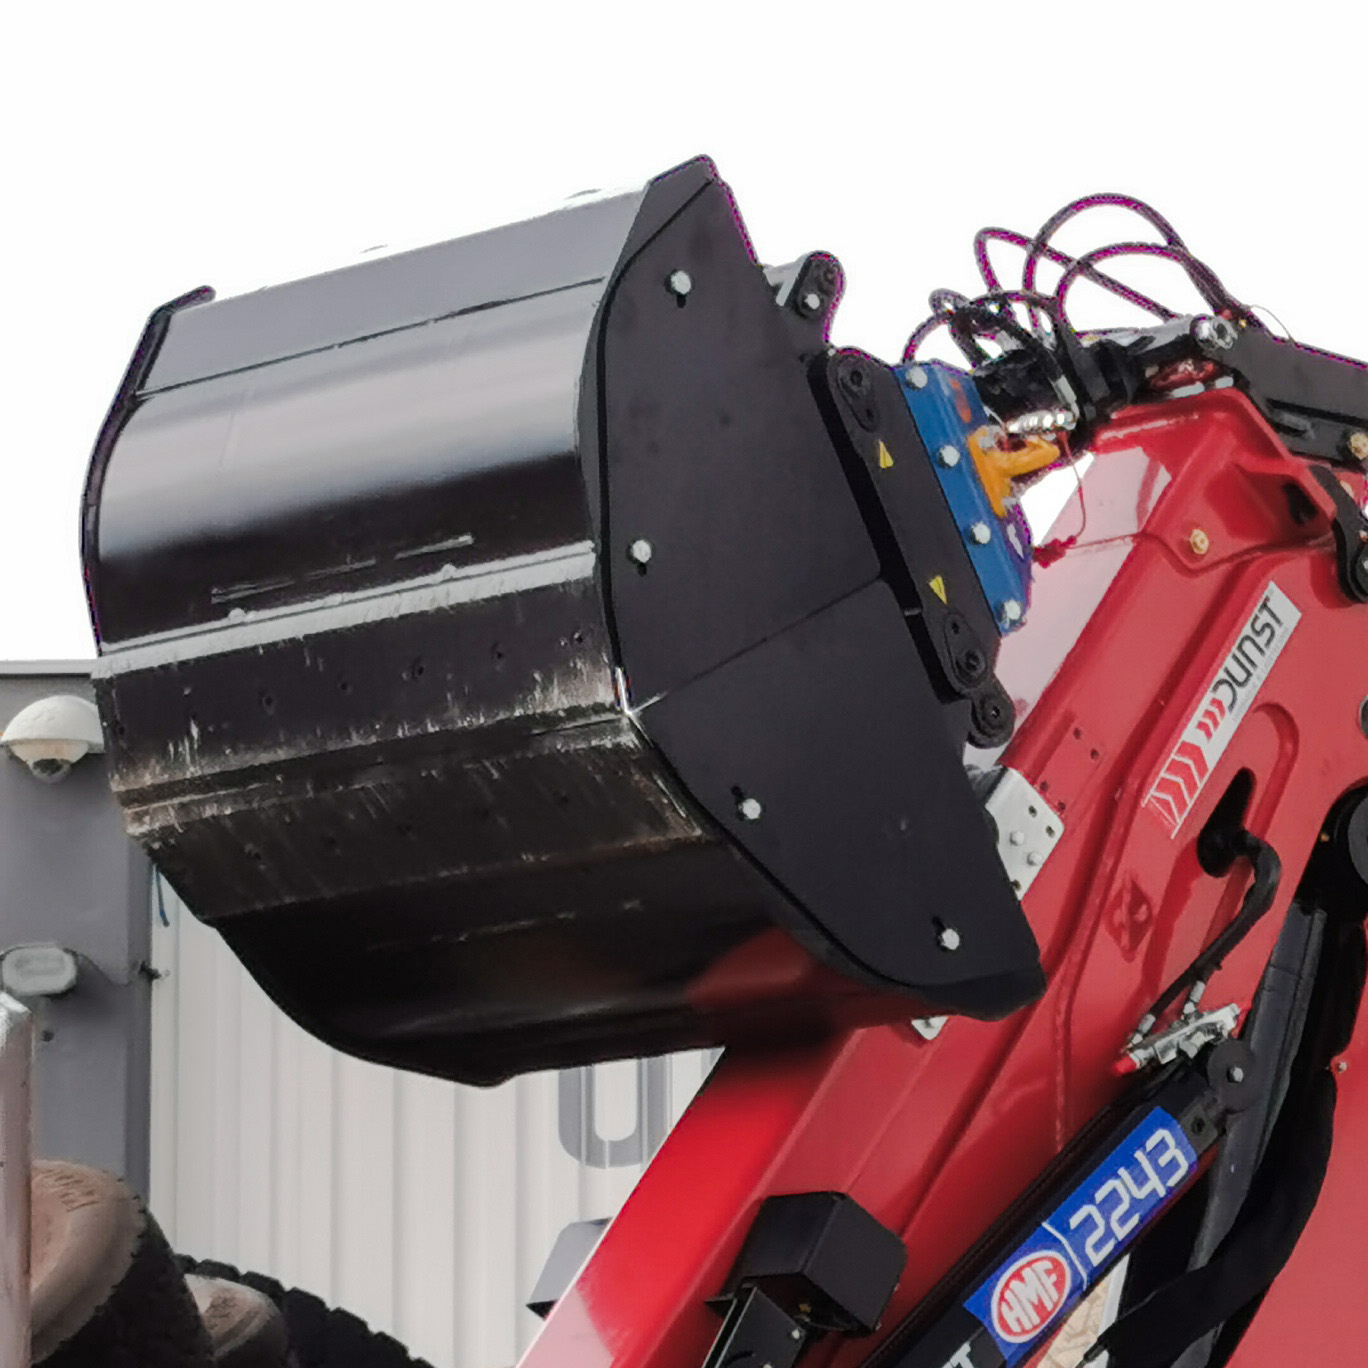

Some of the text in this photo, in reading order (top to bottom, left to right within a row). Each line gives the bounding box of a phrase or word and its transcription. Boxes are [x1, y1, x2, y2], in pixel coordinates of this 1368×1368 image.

[1210, 596, 1284, 713] DUNST
[1000, 1128, 1189, 1333] HMF 2243
